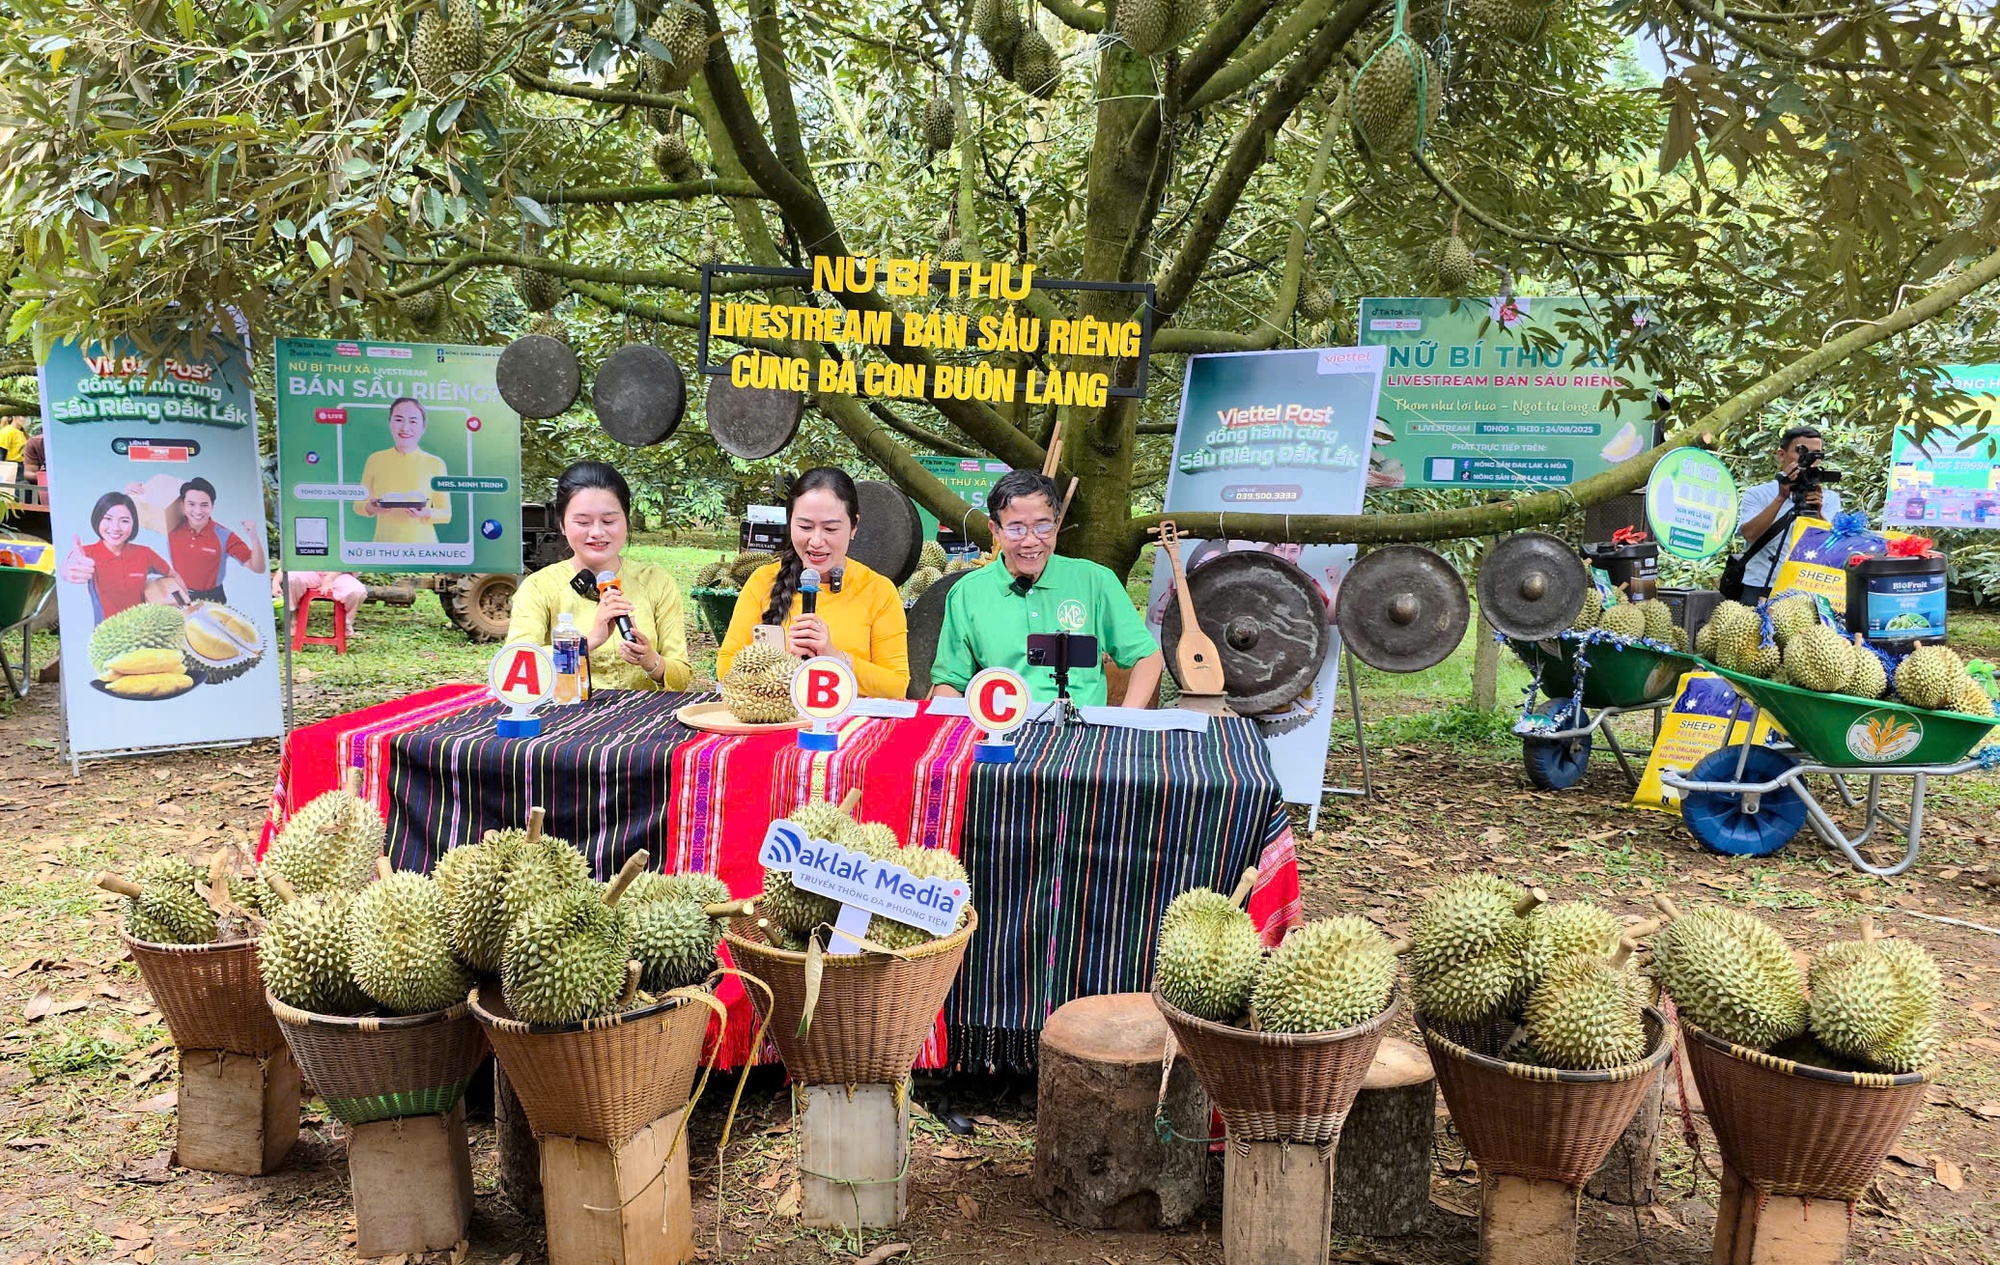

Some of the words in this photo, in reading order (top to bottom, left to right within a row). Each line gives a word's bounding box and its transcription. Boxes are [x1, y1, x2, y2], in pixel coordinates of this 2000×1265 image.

[887, 253, 933, 296] BÍ
[940, 261, 1037, 301] THƯ
[709, 301, 893, 346] LIVESTREAM
[903, 307, 968, 350] BÁN
[1048, 315, 1142, 358] RIÊNG
[1325, 352, 1372, 364] viettel
[1389, 340, 1439, 368] NỮ
[1449, 340, 1485, 368] BÍ
[1495, 342, 1568, 368] THƯ
[288, 360, 307, 372] NỮ
[310, 361, 323, 372] BÍ
[326, 363, 352, 373] THƯ
[355, 363, 371, 374] XÃ
[289, 373, 345, 397] BÁN
[731, 347, 810, 392] CÙNG
[818, 352, 858, 394] BÀ
[864, 361, 926, 398] CON
[933, 361, 1016, 403] BUÔN
[1025, 362, 1109, 408] LÀNG
[1387, 374, 1488, 387] LIVESTREAM
[1493, 372, 1529, 388] BÁN
[1534, 371, 1568, 387] SẦU
[178, 381, 222, 401] cùng
[52, 396, 97, 418] Sầu
[99, 397, 161, 418] Riêng
[164, 398, 207, 418] Đắk
[210, 402, 249, 424] Lắk
[1217, 404, 1282, 426] Viettel
[1285, 404, 1335, 424] Post
[1295, 425, 1339, 444] cùng
[1418, 424, 1470, 432] LIVESTREAM
[1483, 425, 1509, 433] 10H00
[1219, 446, 1275, 466] Riêng
[950, 477, 971, 487] THƯ
[973, 477, 987, 487] XÃ
[348, 547, 363, 557] NỮ
[366, 548, 375, 557] BÍ
[378, 549, 400, 557] THƯ
[402, 549, 416, 557] XÃ
[418, 550, 466, 558] EAKNUEC
[1798, 569, 1841, 584] SHEEP
[501, 651, 542, 695] A
[807, 669, 841, 709] B
[979, 679, 1017, 720] C
[1680, 719, 1716, 732] SHEEP
[874, 868, 955, 914] Media
[871, 896, 884, 907] ĐA
